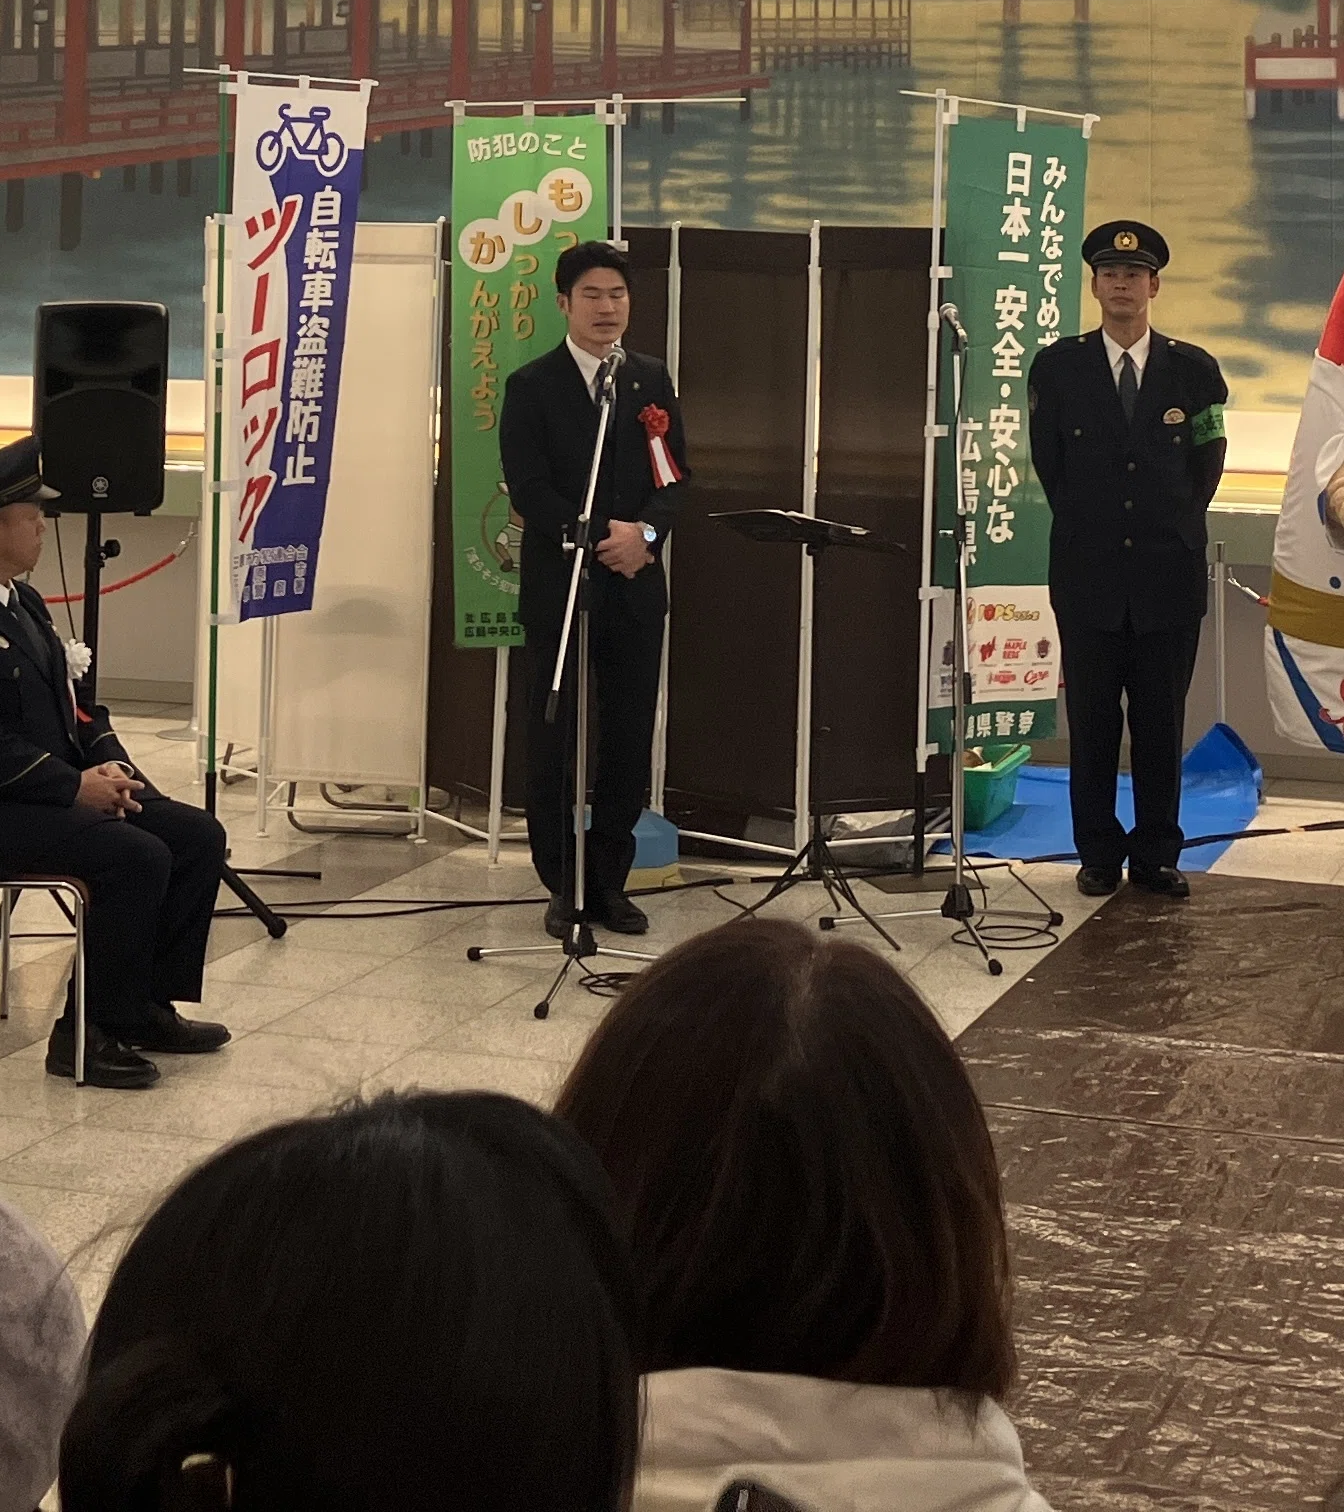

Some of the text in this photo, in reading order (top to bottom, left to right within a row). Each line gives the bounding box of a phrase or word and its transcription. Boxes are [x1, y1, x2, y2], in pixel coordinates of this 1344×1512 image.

[466, 131, 589, 164] 防犯のこと
[236, 194, 300, 544] ツーロック
[280, 184, 343, 489] 自転車盗難防止
[468, 230, 506, 433] かんがえよう
[511, 200, 545, 341] しっかり
